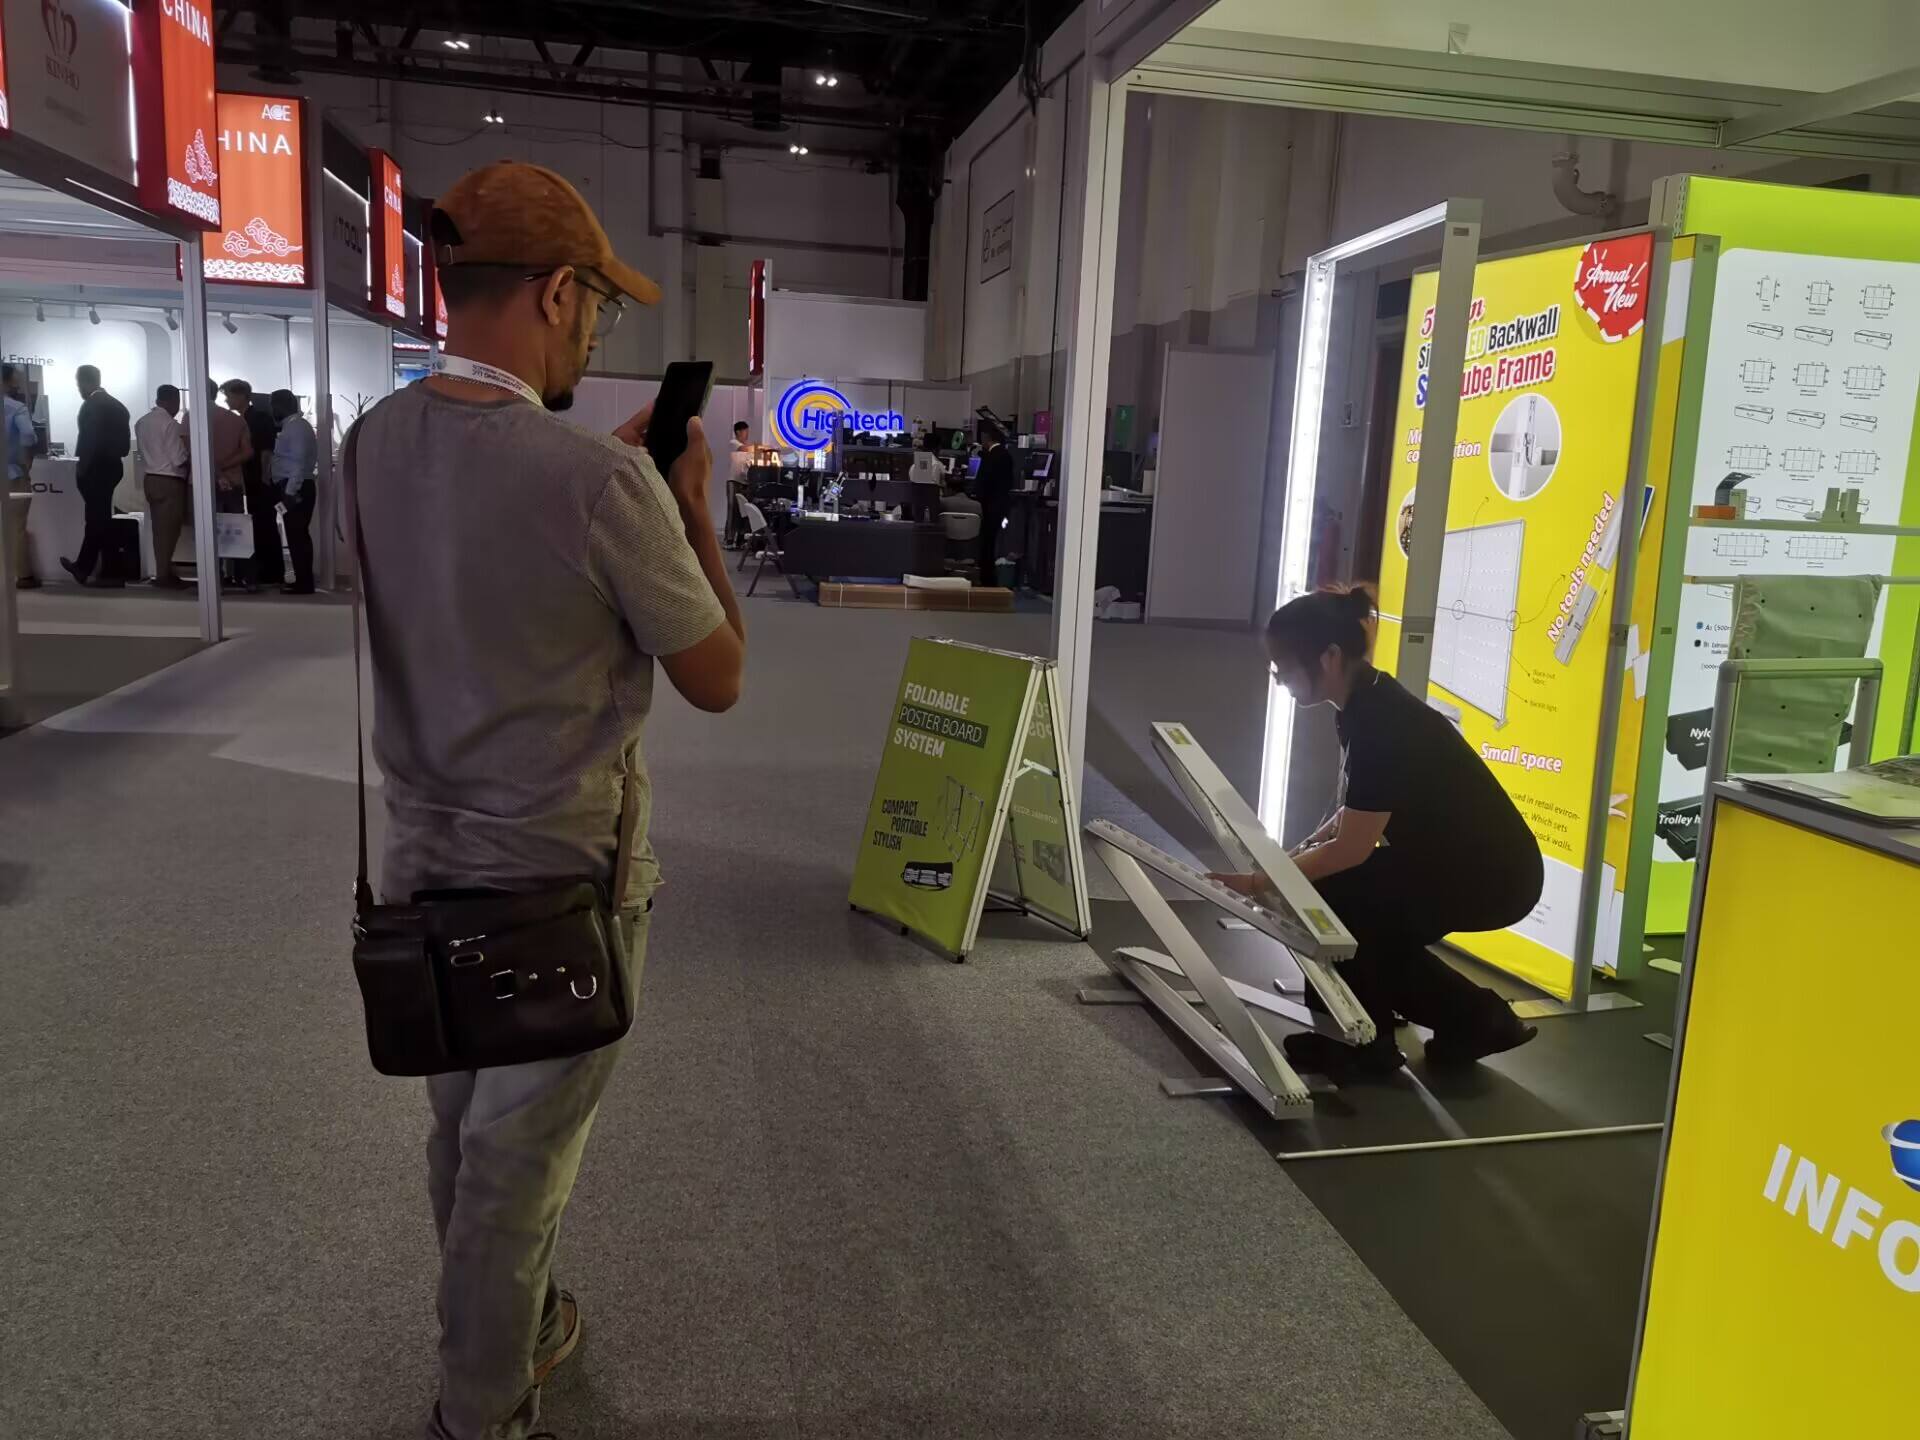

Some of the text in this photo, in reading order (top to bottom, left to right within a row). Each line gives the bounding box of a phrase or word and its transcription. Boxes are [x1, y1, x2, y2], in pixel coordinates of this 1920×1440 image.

[163, 0, 210, 47] CHINA
[218, 130, 293, 156] HINA
[1604, 283, 1638, 313] New
[1488, 306, 1558, 351] Backwall
[1460, 365, 1492, 397] ube
[1496, 349, 1554, 389] Frame
[1547, 490, 1615, 642] No tools needed
[904, 682, 970, 715] FOLDABLE
[900, 706, 982, 743] POSTER BOARD
[894, 727, 946, 758] SYSTEM
[1481, 742, 1563, 773] Small space
[881, 799, 920, 817] COMPACT
[1526, 796, 1534, 805] in
[1534, 799, 1554, 811] retail
[891, 816, 928, 838] PORTABLE
[1531, 812, 1553, 827] Which
[1553, 820, 1568, 833] sets
[1659, 814, 1693, 827] Trolley
[873, 830, 902, 852] STYLISH
[1763, 1143, 1920, 1293] INFO
